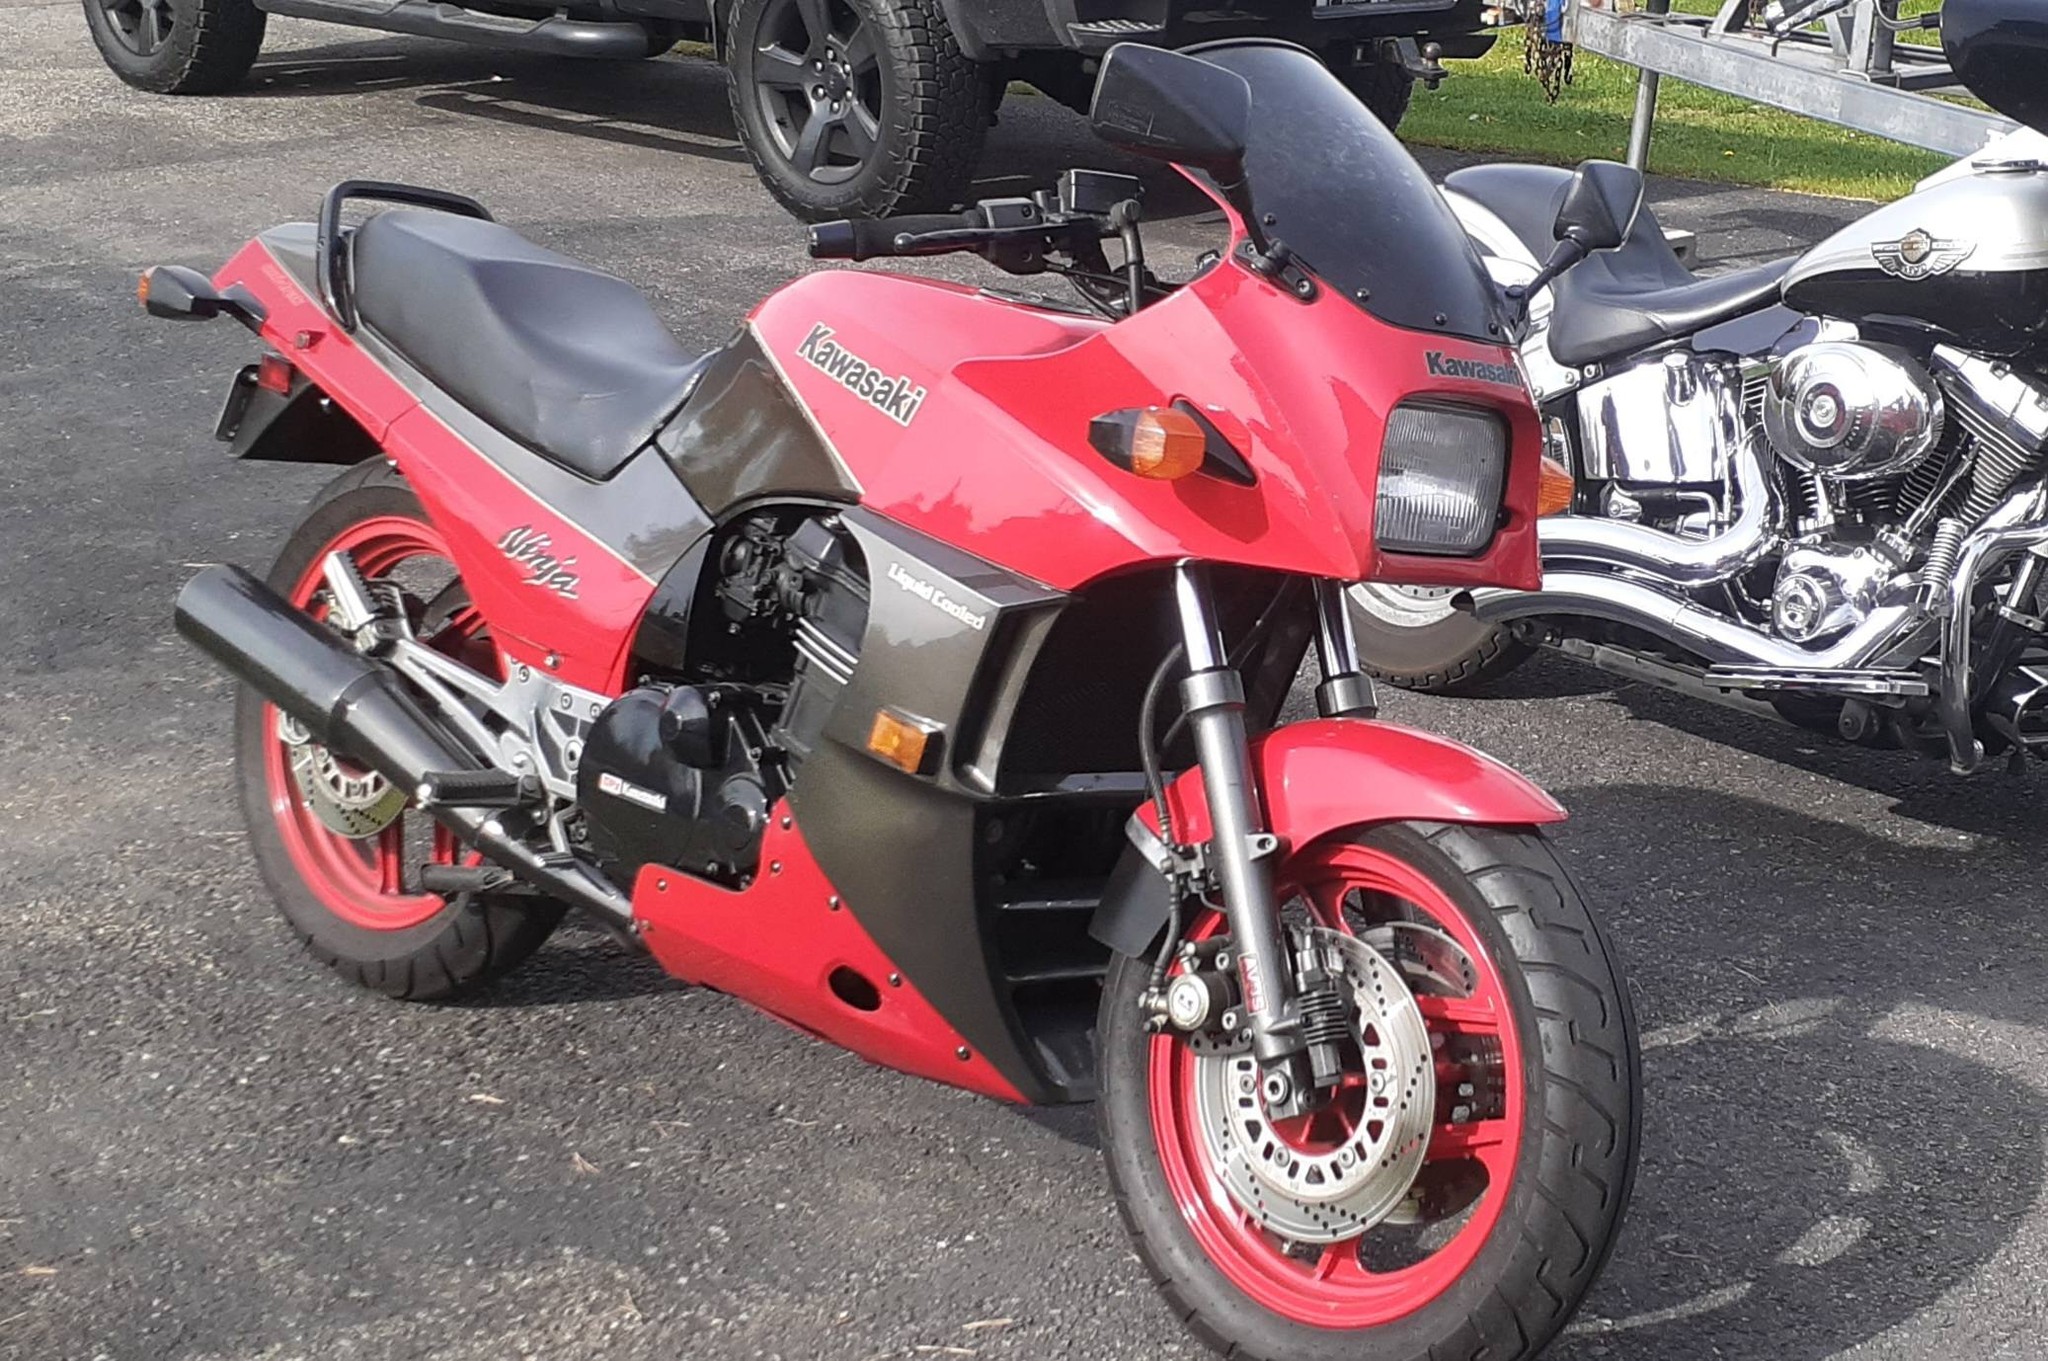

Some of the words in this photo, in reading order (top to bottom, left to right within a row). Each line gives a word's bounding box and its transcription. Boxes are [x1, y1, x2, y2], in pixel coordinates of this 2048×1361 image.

[796, 321, 927, 427] Kawasaki
[1424, 350, 1521, 386] Kawasaki
[498, 525, 580, 600] Ninja
[887, 562, 934, 601] Liquid
[931, 589, 986, 630] Cooled
